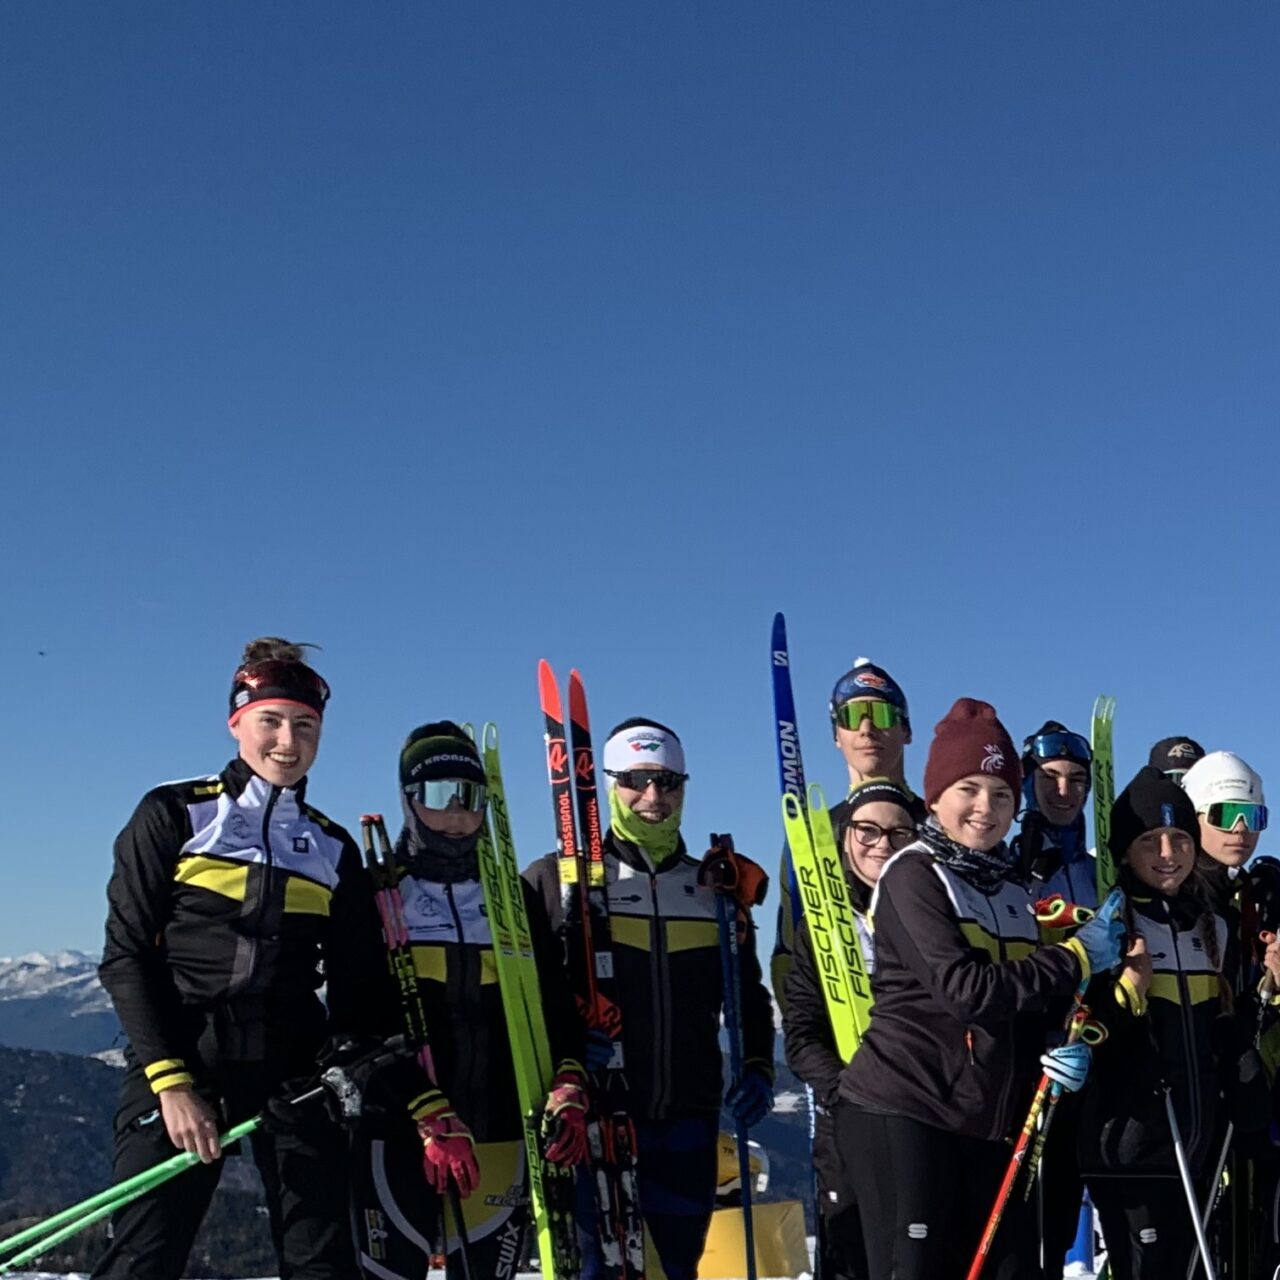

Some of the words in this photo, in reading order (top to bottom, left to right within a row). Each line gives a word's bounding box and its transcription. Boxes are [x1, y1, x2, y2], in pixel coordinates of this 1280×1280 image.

[493, 792, 529, 934] FISCHER
[559, 789, 575, 857] ROSSIGNOL
[587, 797, 602, 862] ROSSIGNOL
[799, 865, 846, 1005] FISCHER
[823, 856, 869, 1000] FISCHER
[525, 1128, 545, 1210] ISCHER
